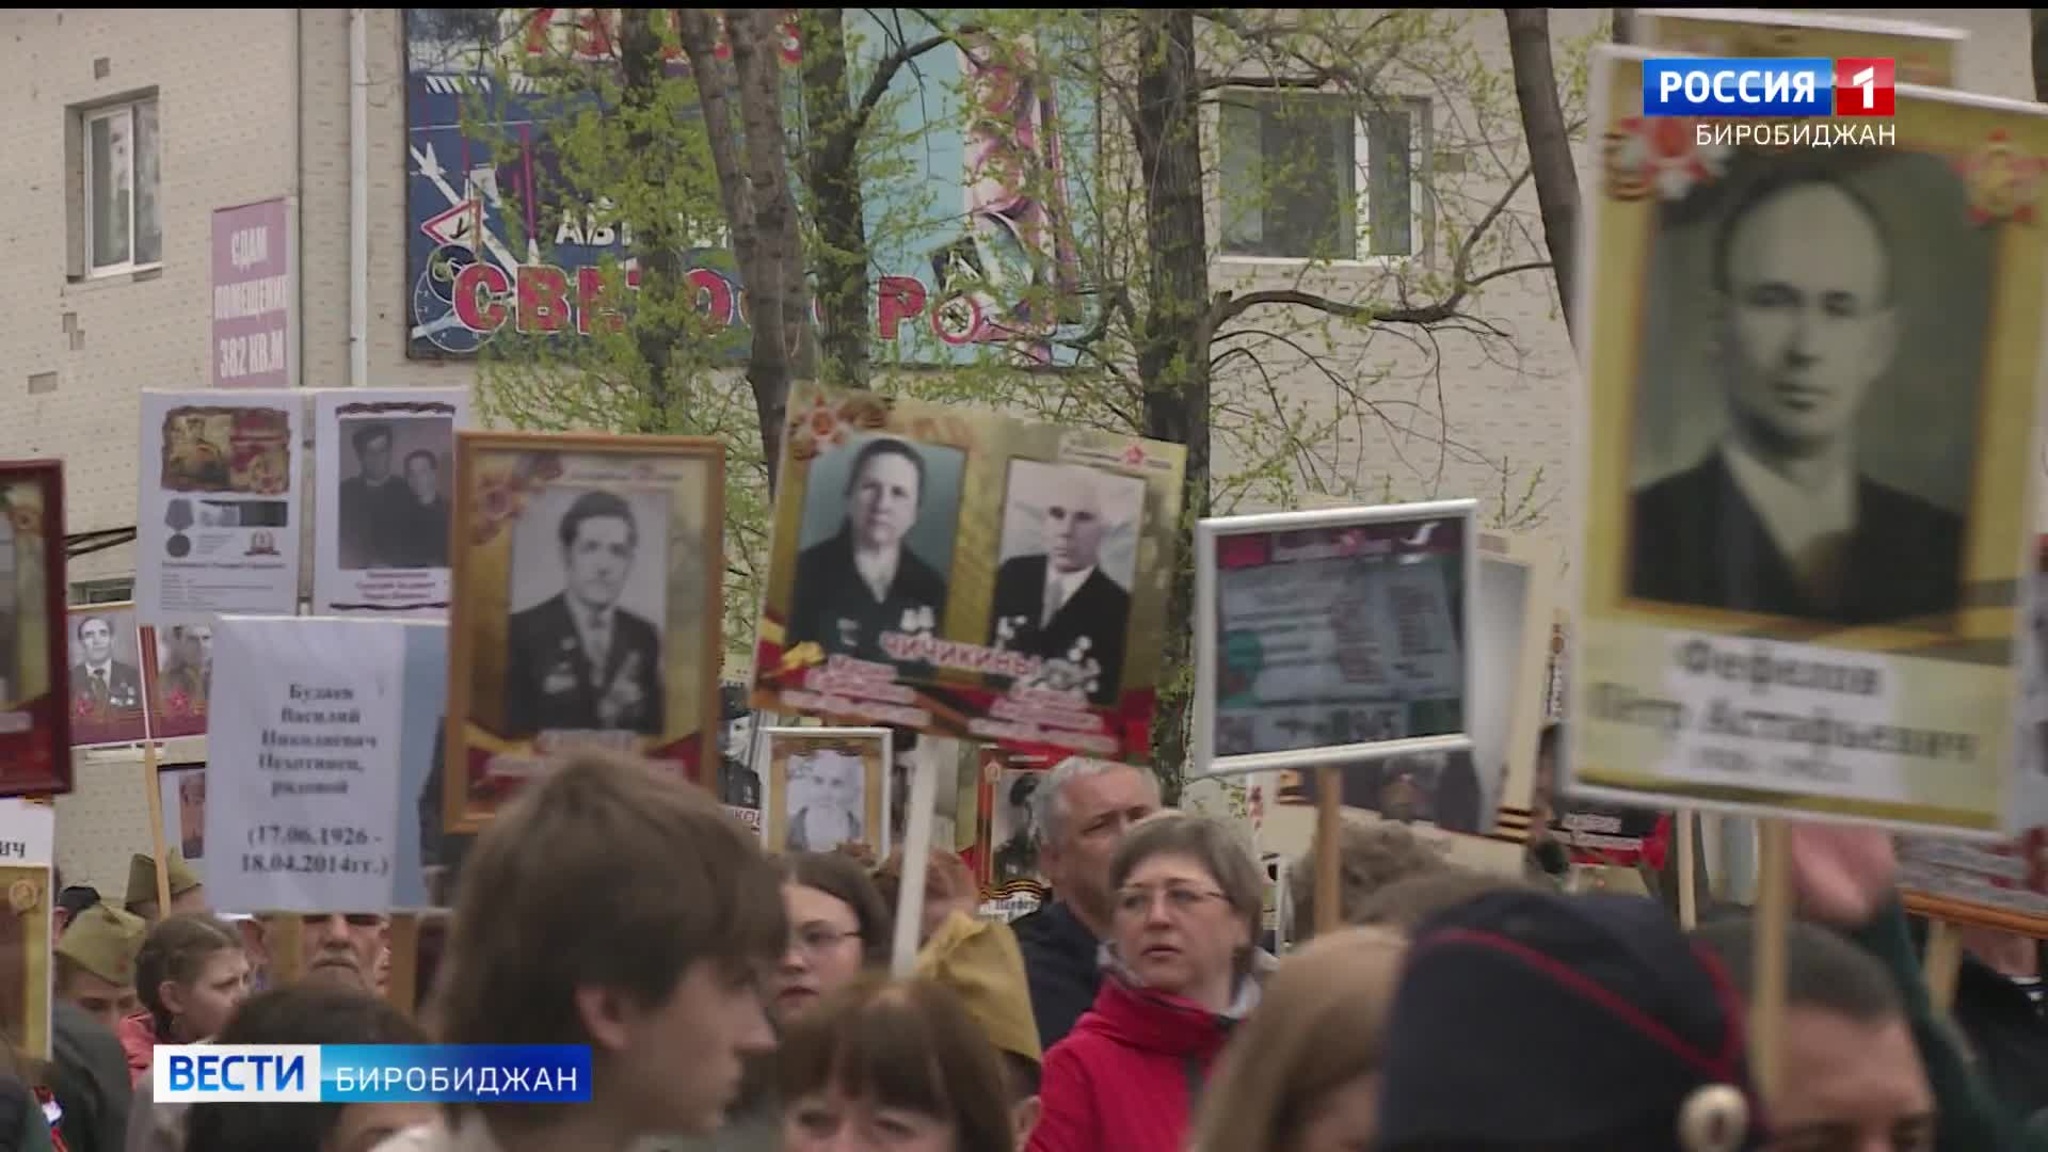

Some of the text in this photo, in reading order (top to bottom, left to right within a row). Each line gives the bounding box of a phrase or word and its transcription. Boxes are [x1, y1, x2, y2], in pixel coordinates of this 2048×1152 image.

[231, 226, 268, 273] СДАМ
[220, 334, 247, 378] 382
[880, 631, 1044, 677] ЧИЧИКИНЫ
